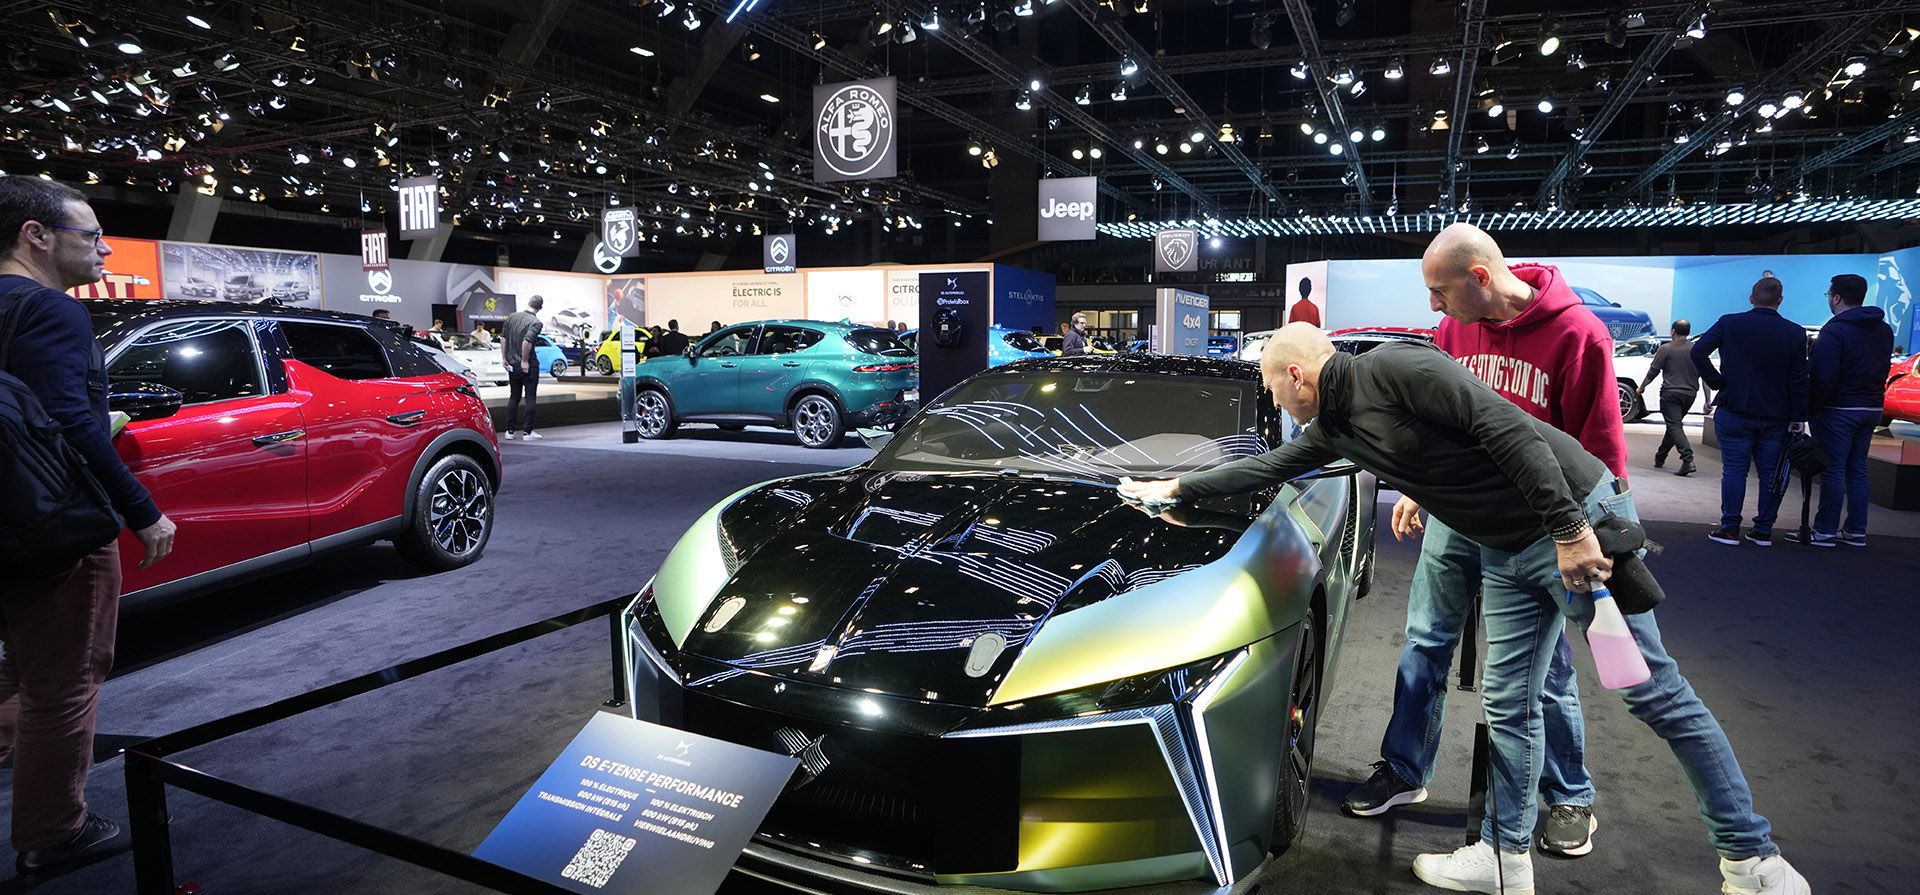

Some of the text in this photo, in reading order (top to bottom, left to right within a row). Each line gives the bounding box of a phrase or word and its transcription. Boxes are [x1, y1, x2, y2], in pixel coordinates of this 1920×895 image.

[821, 90, 888, 134] ALFA ROMEO
[399, 185, 437, 231] FIAT
[1040, 198, 1094, 221] Jeep
[361, 232, 386, 264] FIAT
[773, 287, 782, 296] IS
[892, 284, 920, 294] CITRO
[1175, 293, 1209, 308] AVENGER
[1455, 354, 1549, 408] SHINGTON DC
[580, 755, 744, 808] DS E-TENSE PERFORMANCE
[580, 778, 594, 788] 100
[538, 791, 588, 811] TRANSMISSION
[650, 798, 664, 808] 100
[669, 803, 715, 822] ELEKTRISCH
